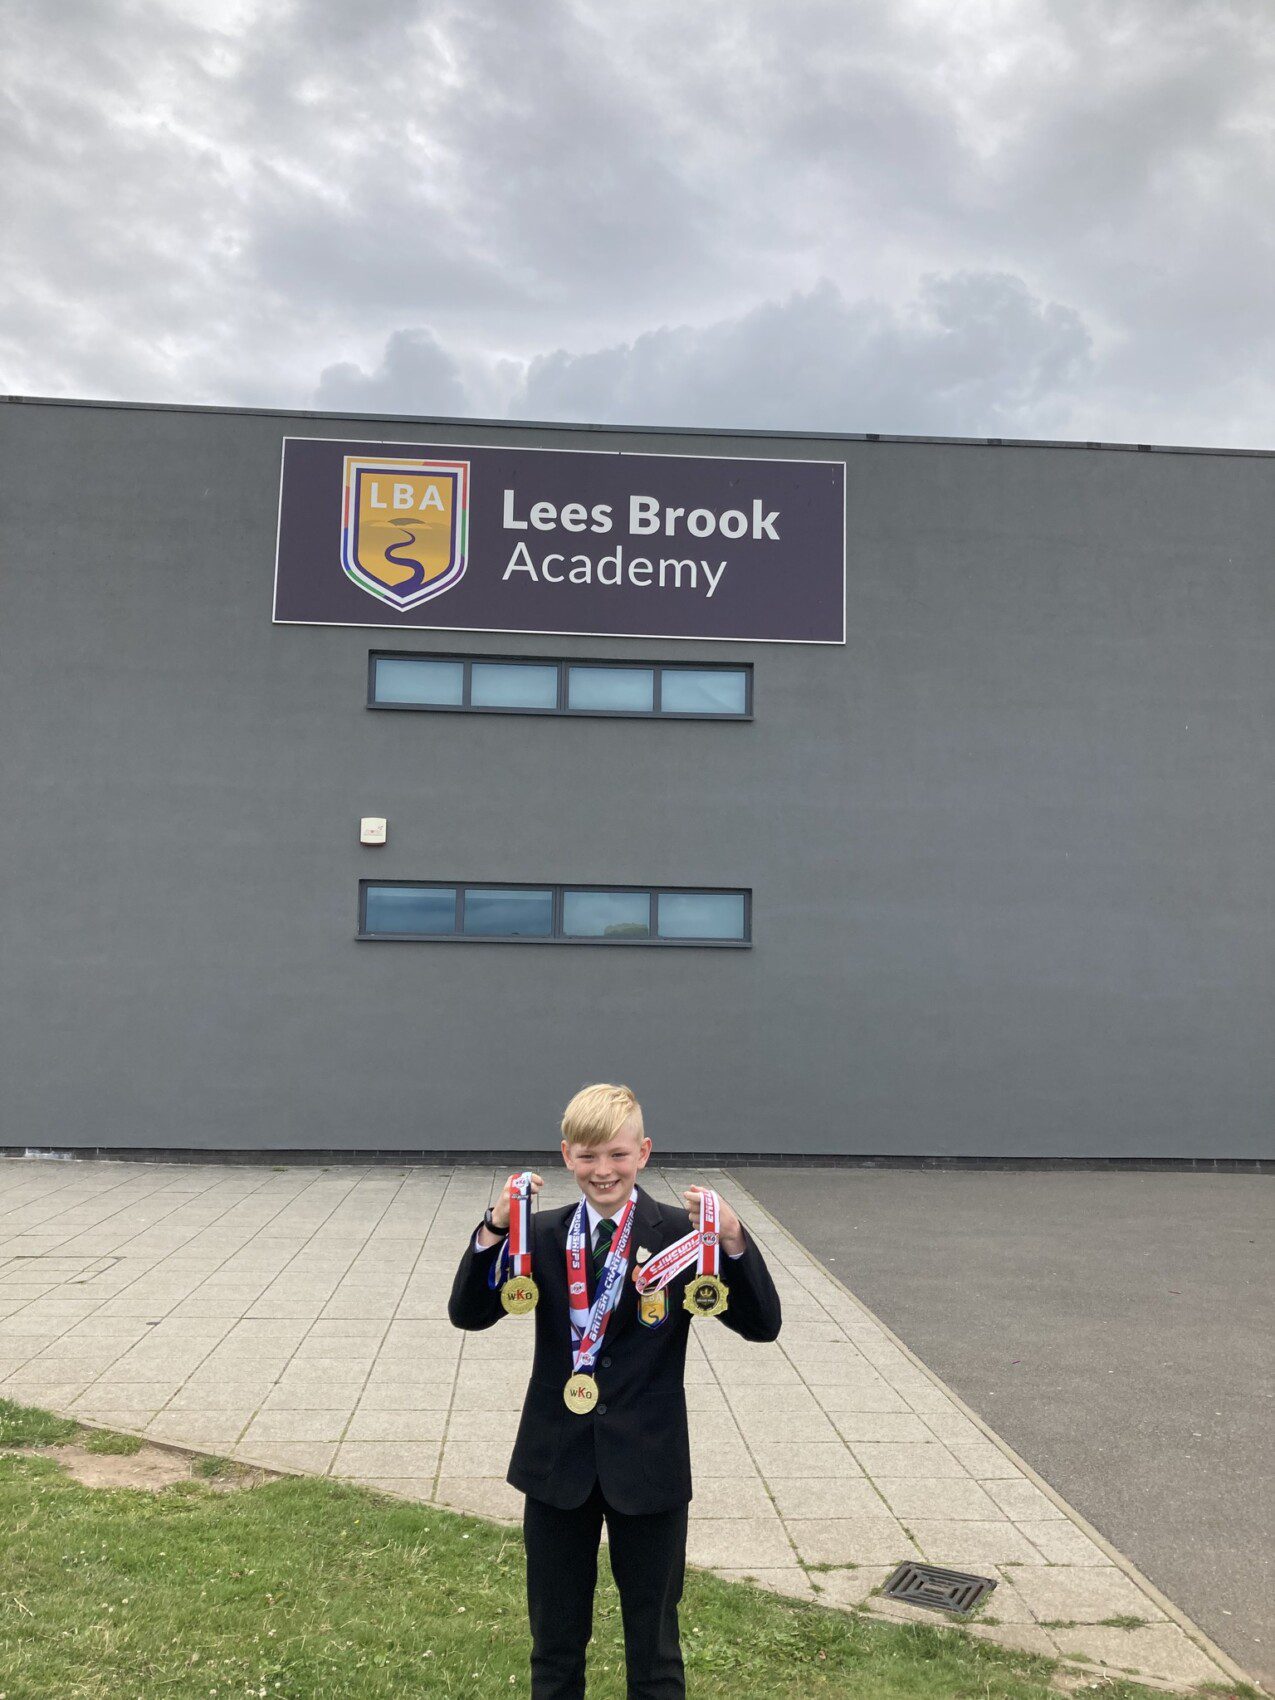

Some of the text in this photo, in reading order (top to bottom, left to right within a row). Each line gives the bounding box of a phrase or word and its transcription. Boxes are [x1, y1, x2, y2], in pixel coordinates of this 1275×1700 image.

[370, 481, 446, 512] LBA
[503, 488, 781, 540] Lees Brook
[501, 541, 728, 598] Academy
[588, 1203, 637, 1342] BRITISH CHAMPIONSHIPS
